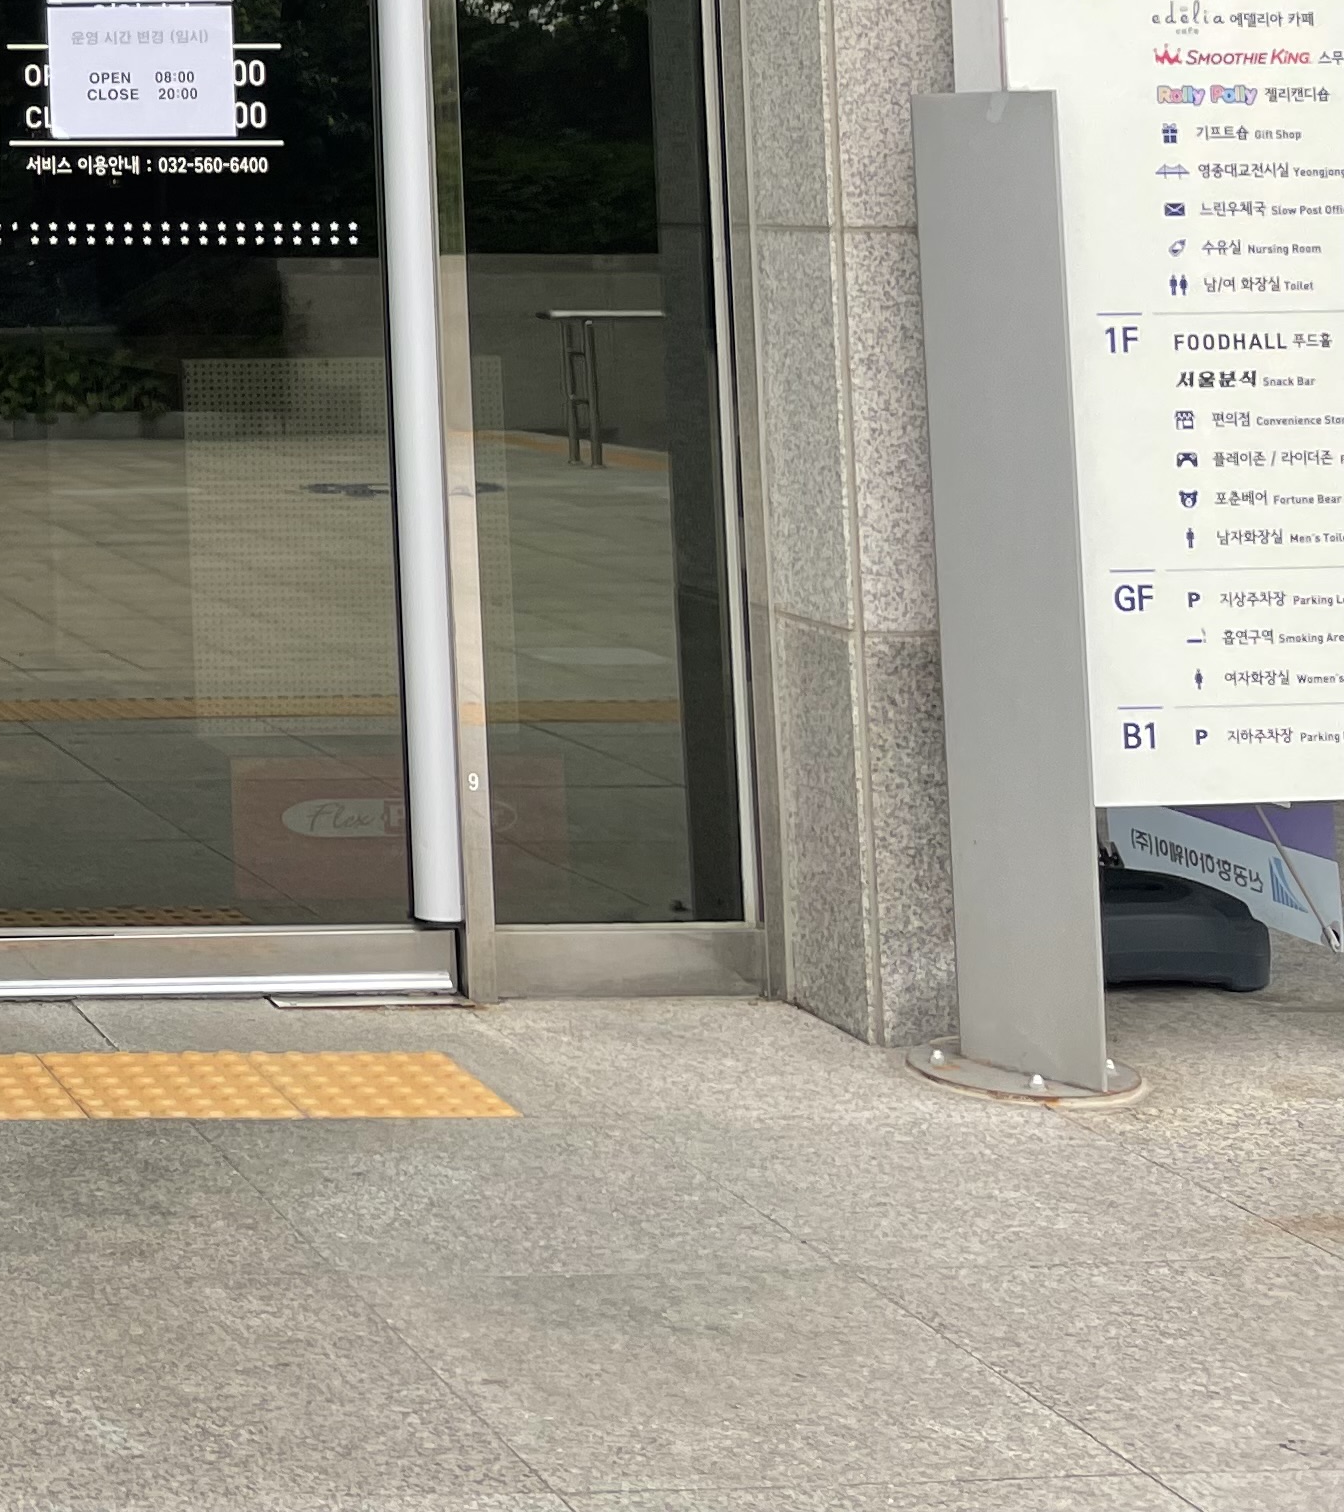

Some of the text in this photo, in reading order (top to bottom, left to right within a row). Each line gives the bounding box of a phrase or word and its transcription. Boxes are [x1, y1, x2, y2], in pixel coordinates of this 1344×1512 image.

[1230, 11, 1314, 27] 에델리아 카페
[71, 29, 209, 45] 운영 시간 변경 (임시)
[1186, 50, 1267, 65] SMOOTHIE
[89, 71, 195, 85] OPEN 08:00
[87, 87, 198, 102] CLOSE 20:00
[1157, 85, 1205, 106] Rolly
[1211, 85, 1258, 105] Polly
[1196, 125, 1302, 142] 기프트숍 Gift Shop
[26, 155, 72, 176] 서비스
[77, 155, 140, 176] 이용안내
[158, 156, 268, 174] 032-560-6400
[1198, 163, 1290, 179] 영종대교전시실
[1200, 201, 1266, 216] 느린우체국
[1271, 205, 1297, 216] Slow
[1299, 205, 1323, 215] Post
[1201, 239, 1322, 256] 수유실 Nursing Room
[1203, 276, 1314, 293] 남/여 화장실 Toilet
[1104, 326, 1333, 353] 1F FOODHALL 푸드홀
[1176, 370, 1316, 389] 서울분식 Snack Bar
[1212, 412, 1251, 427] 편의점
[1256, 415, 1323, 426] Convenience
[1213, 452, 1266, 467] 플레이존
[1281, 450, 1334, 466] 라이더존
[1214, 491, 1342, 507] 포춘베어 Fortune Bear
[1217, 529, 1283, 545] 남자화장실
[1114, 585, 1154, 611] GF
[1220, 591, 1285, 607] 지상주차장
[1294, 595, 1334, 607] Parking
[1222, 629, 1344, 645] 흡연구역 Smoking Are
[1224, 670, 1290, 686] 여자화장실
[1123, 723, 1156, 749] B1
[1227, 728, 1294, 744] 지하주차장
[1300, 732, 1340, 743] Parking
[468, 772, 480, 791] 9
